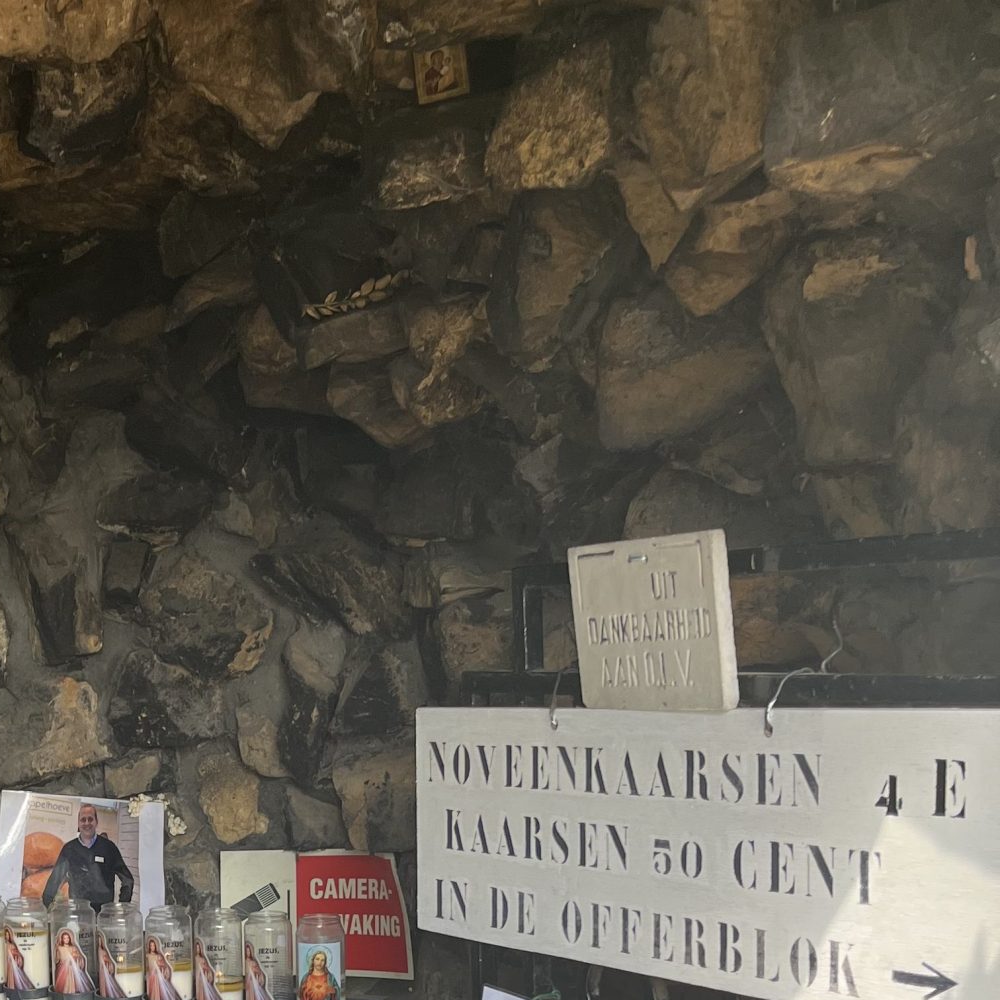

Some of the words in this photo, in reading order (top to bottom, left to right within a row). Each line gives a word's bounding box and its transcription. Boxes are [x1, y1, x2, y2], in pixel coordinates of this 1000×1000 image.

[651, 571, 677, 600] UIT
[601, 655, 638, 688] AAN
[428, 741, 822, 807] NOVEENKAARSEN
[875, 775, 903, 816] 4
[932, 759, 967, 819] E
[445, 808, 629, 871] KAARSEN
[652, 838, 704, 879] 50
[733, 840, 881, 905] CENT
[310, 877, 393, 900] CAMERA-
[435, 878, 468, 922] IN
[490, 886, 536, 936] DE
[561, 900, 860, 998] OFFERBLOK
